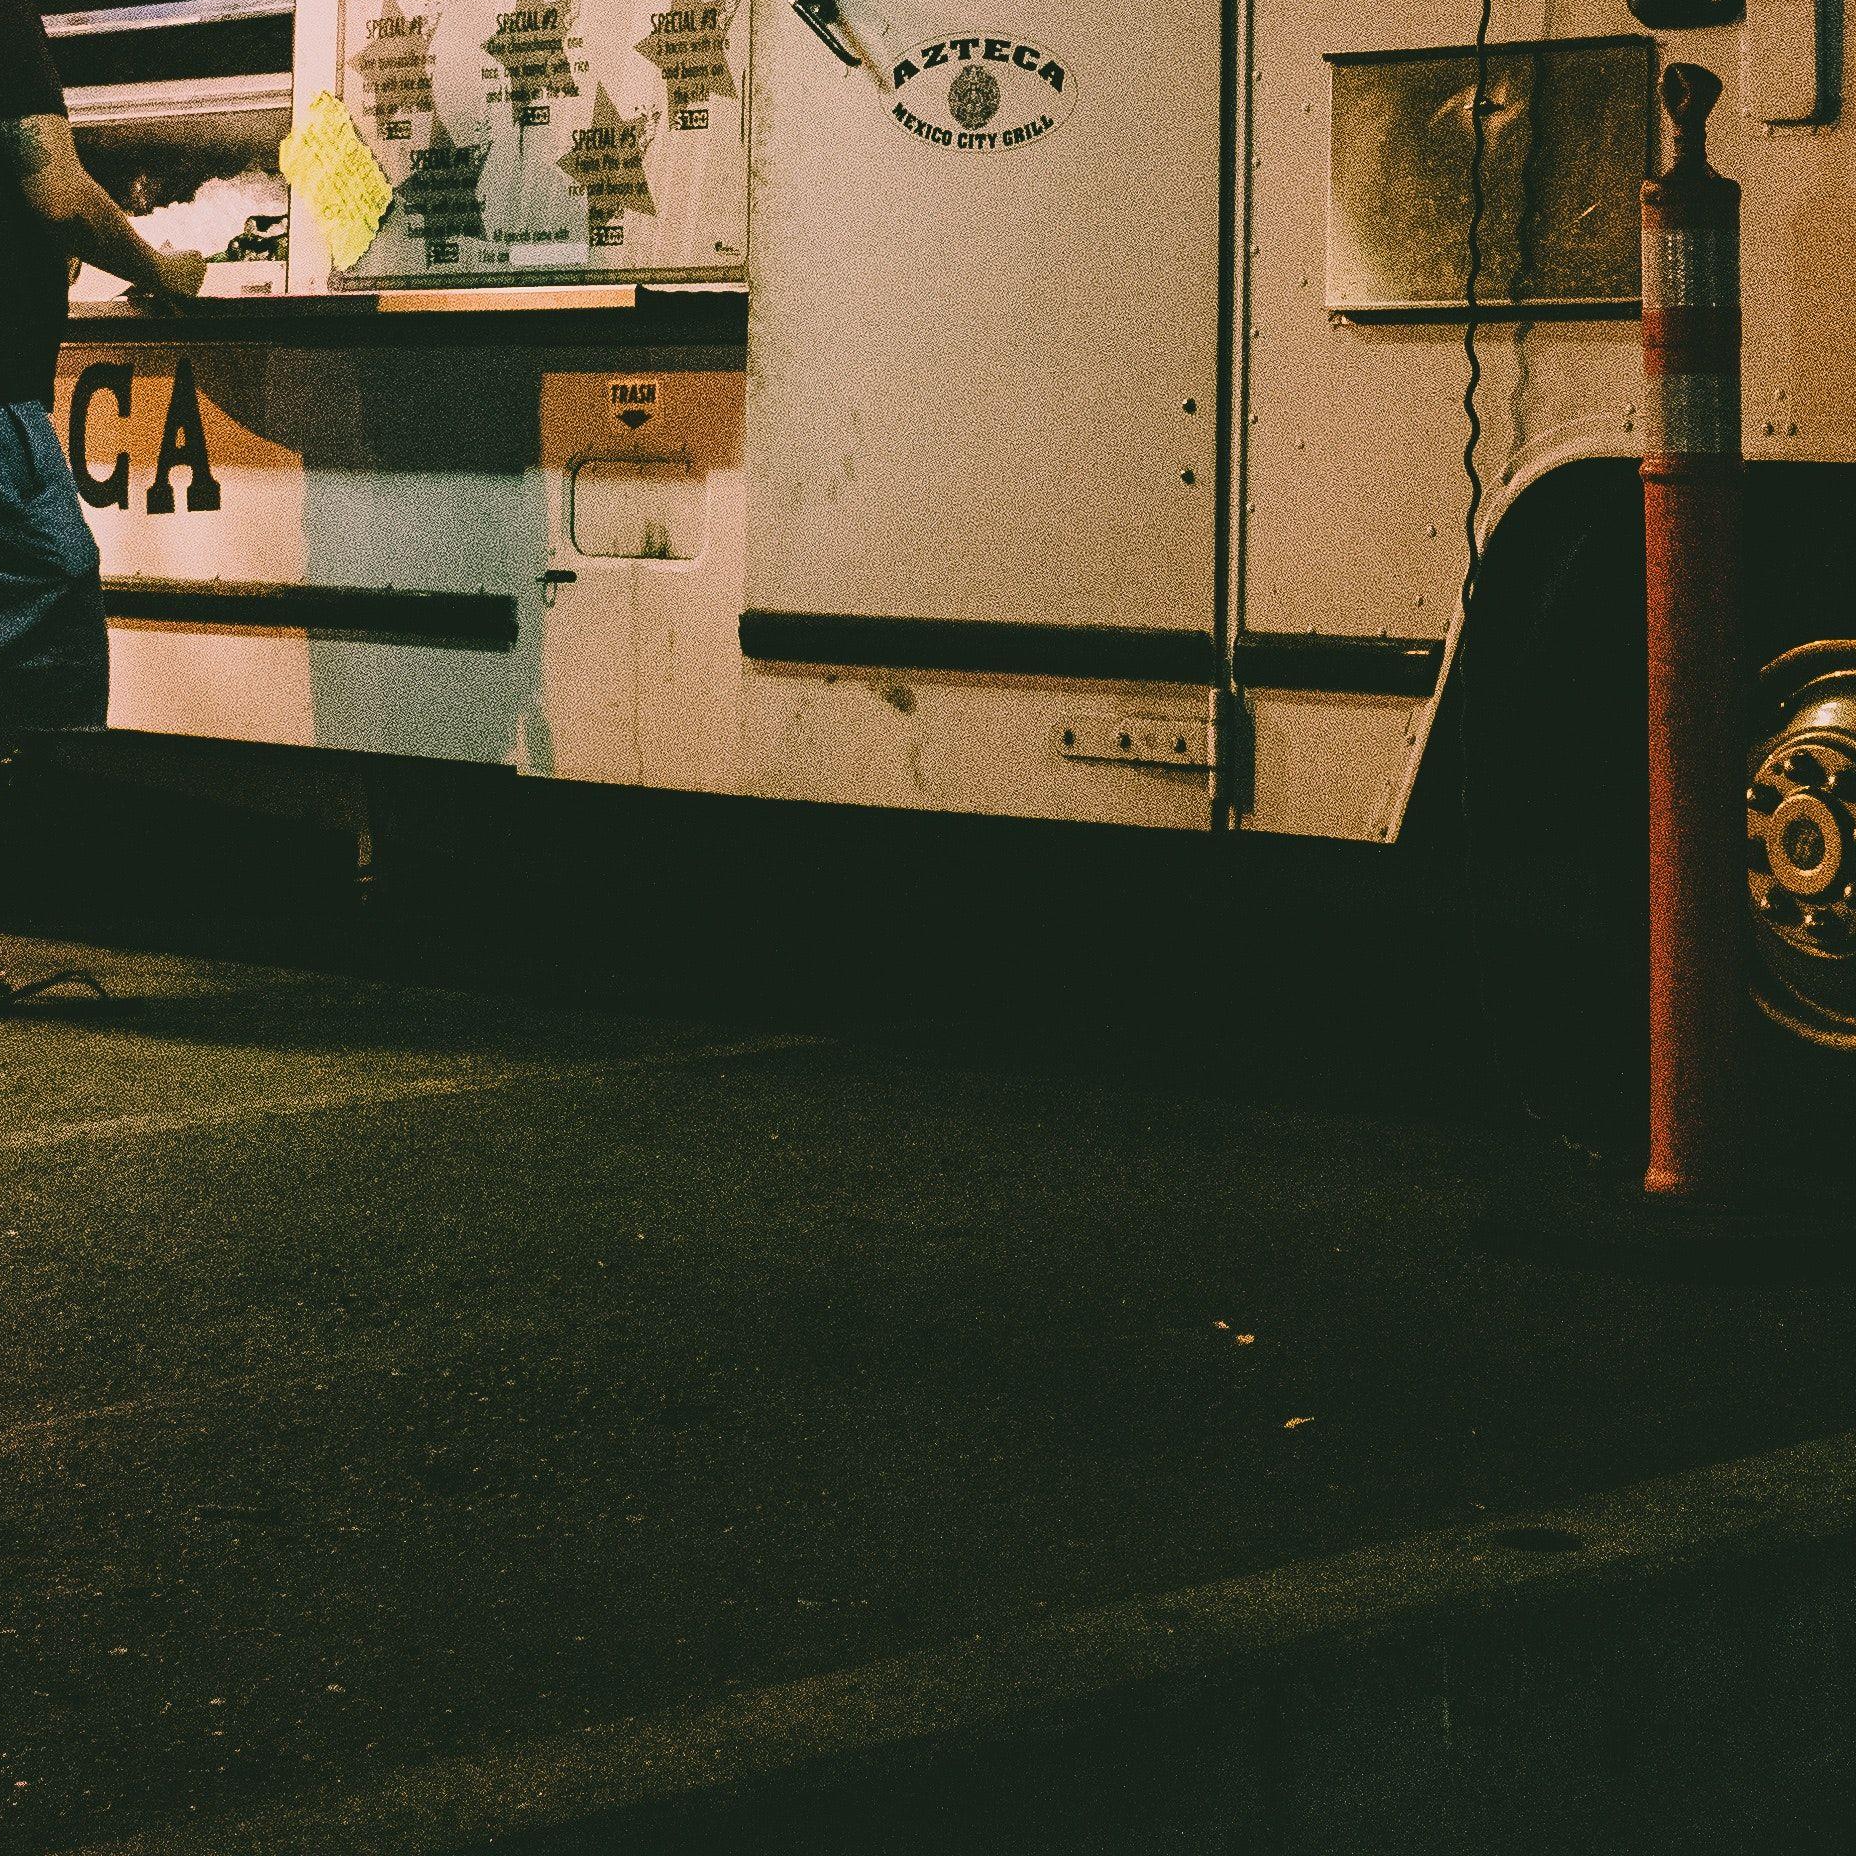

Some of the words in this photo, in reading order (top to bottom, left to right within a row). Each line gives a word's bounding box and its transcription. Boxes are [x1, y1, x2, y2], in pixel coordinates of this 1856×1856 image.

[366, 15, 406, 39] SPECIAL
[495, 10, 539, 35] SPECIAL
[542, 8, 558, 30] #2
[650, 10, 696, 35] SPECIAL
[701, 7, 717, 30] #3
[893, 37, 1065, 93] AZTECA
[571, 126, 616, 151] SPECIAL
[619, 125, 636, 148] #5
[891, 102, 952, 146] MEXICO
[957, 133, 997, 149] CITY
[1002, 114, 1054, 147] GRILL
[610, 384, 656, 405] TRASH
